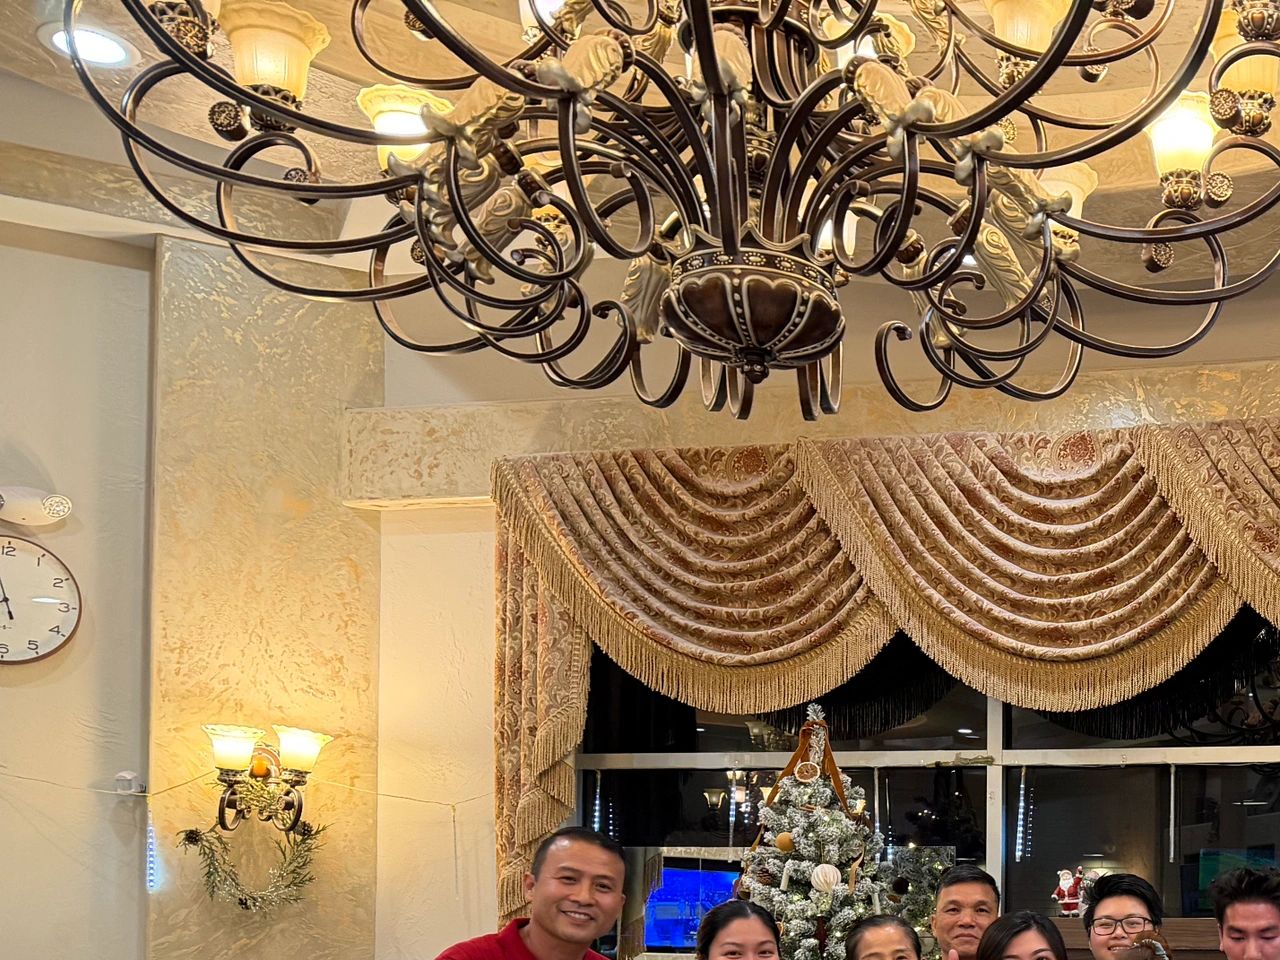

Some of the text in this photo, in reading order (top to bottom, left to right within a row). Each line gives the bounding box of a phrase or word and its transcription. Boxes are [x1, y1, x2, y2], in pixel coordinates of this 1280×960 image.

[1, 545, 16, 557] 12
[53, 577, 64, 588] 2
[58, 602, 70, 613] 3
[48, 625, 61, 636] 4
[27, 640, 39, 651] 5
